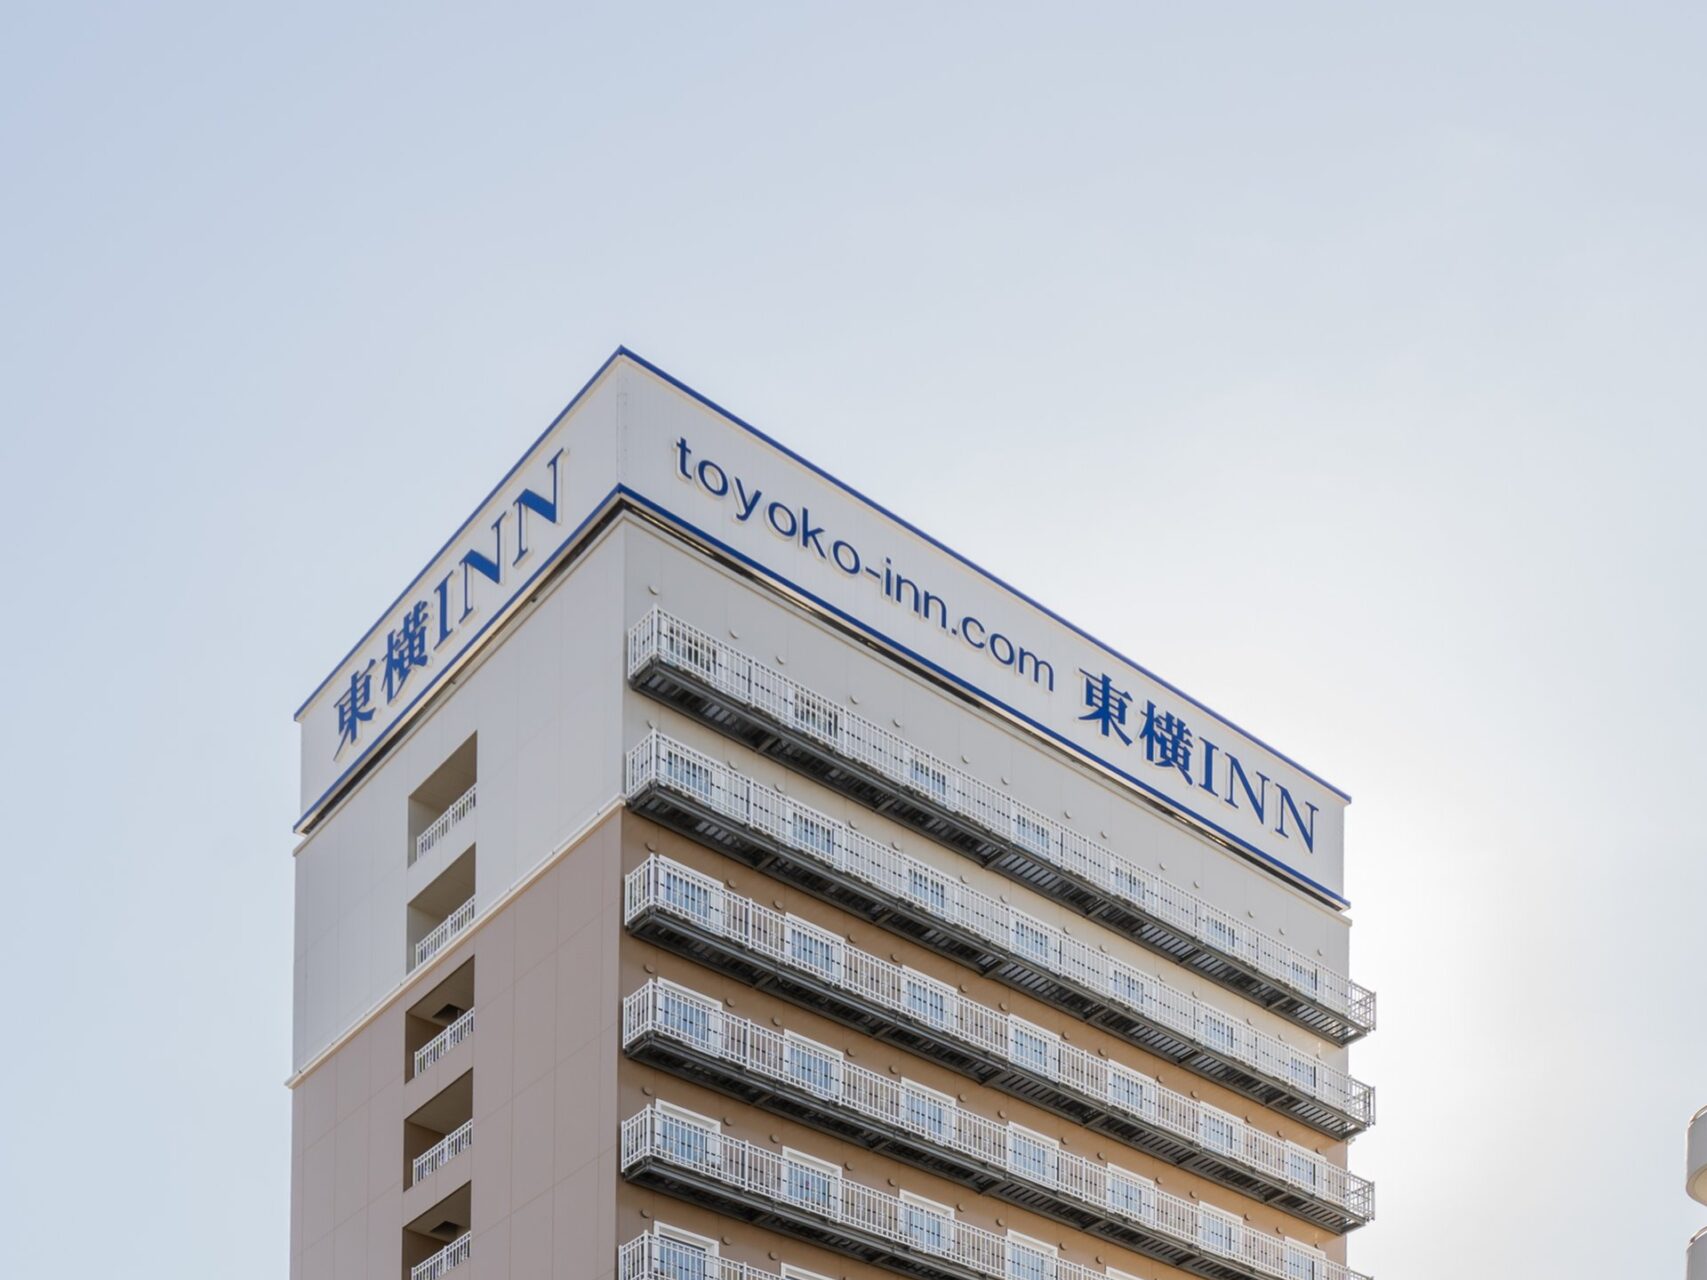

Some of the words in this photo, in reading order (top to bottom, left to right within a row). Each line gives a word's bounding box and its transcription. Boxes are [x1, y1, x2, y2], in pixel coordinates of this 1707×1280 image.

[333, 446, 566, 761] 東横INN
[675, 436, 1054, 692] toyoko-inn.com
[1078, 668, 1319, 854] 東横INN
